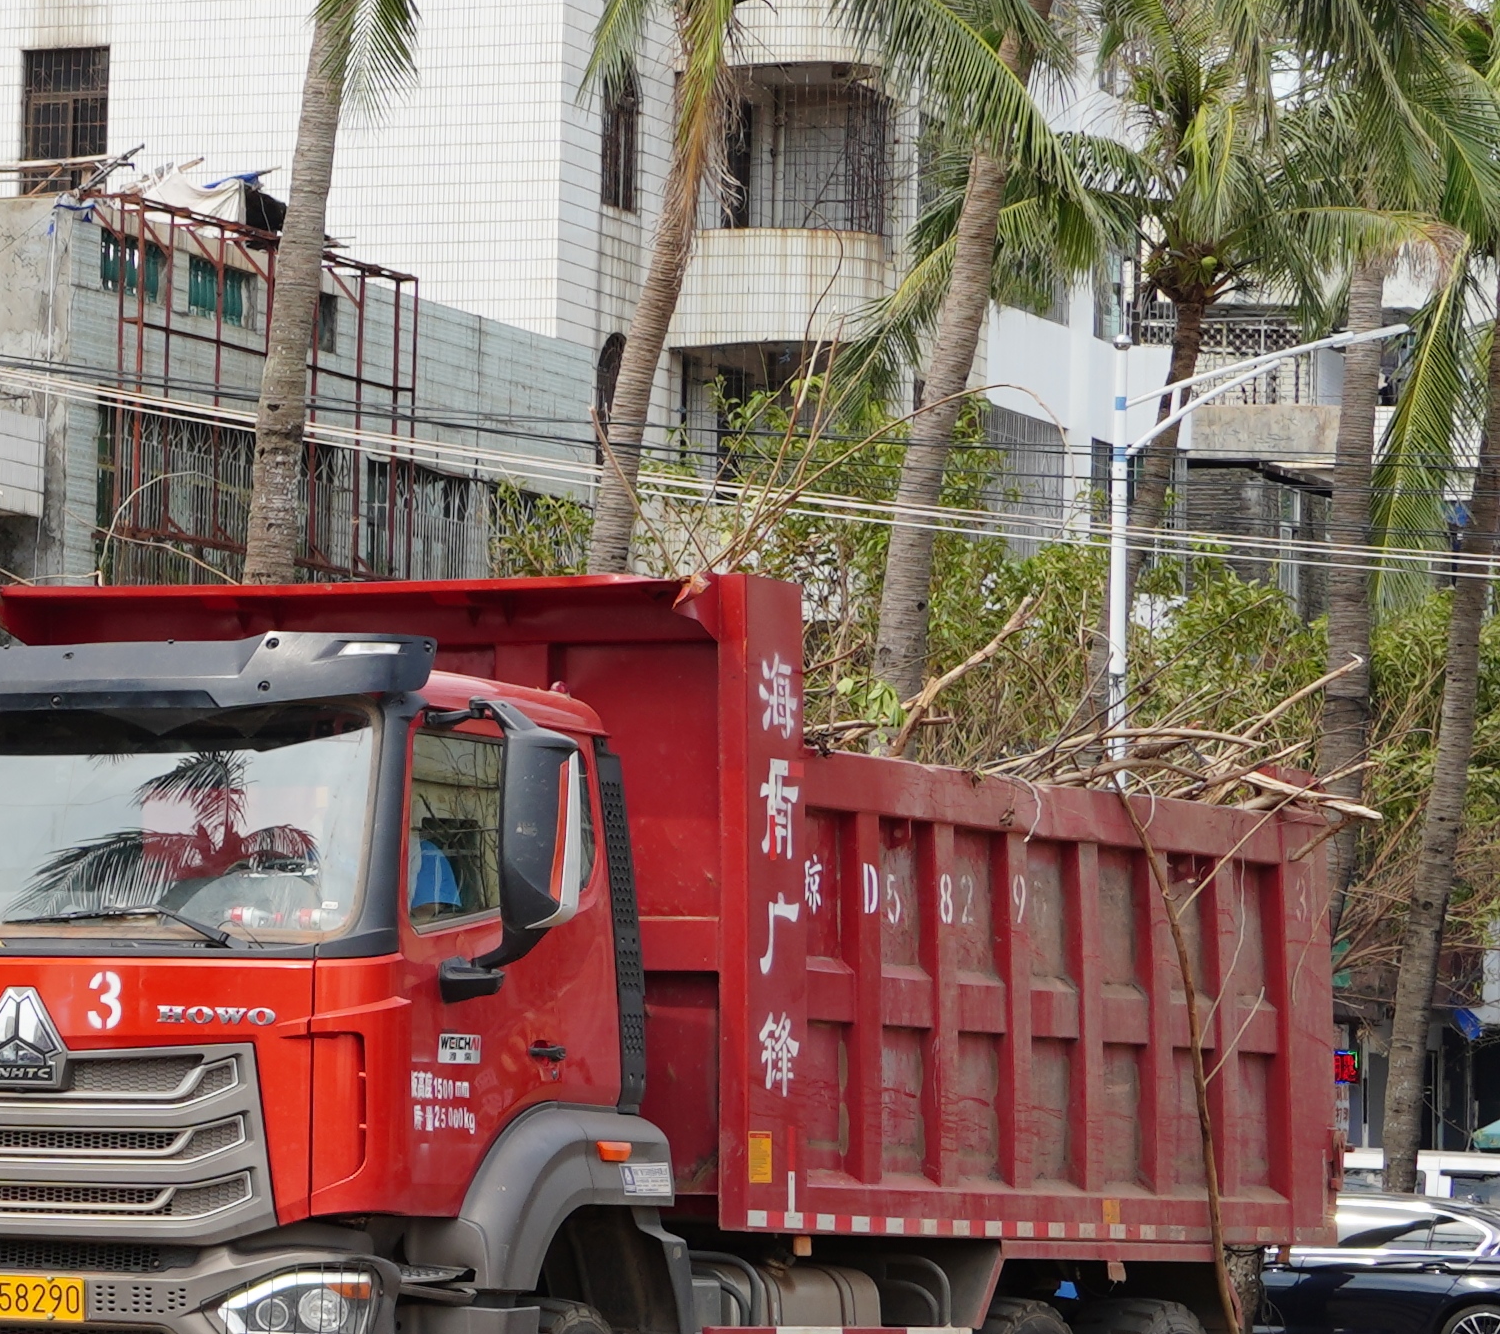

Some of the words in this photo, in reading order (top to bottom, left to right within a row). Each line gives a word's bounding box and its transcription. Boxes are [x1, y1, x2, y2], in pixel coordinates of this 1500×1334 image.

[87, 971, 123, 1030] 3
[156, 1004, 276, 1026] HOWO
[441, 1036, 480, 1051] WEICHAI
[433, 1077, 454, 1099] 1500
